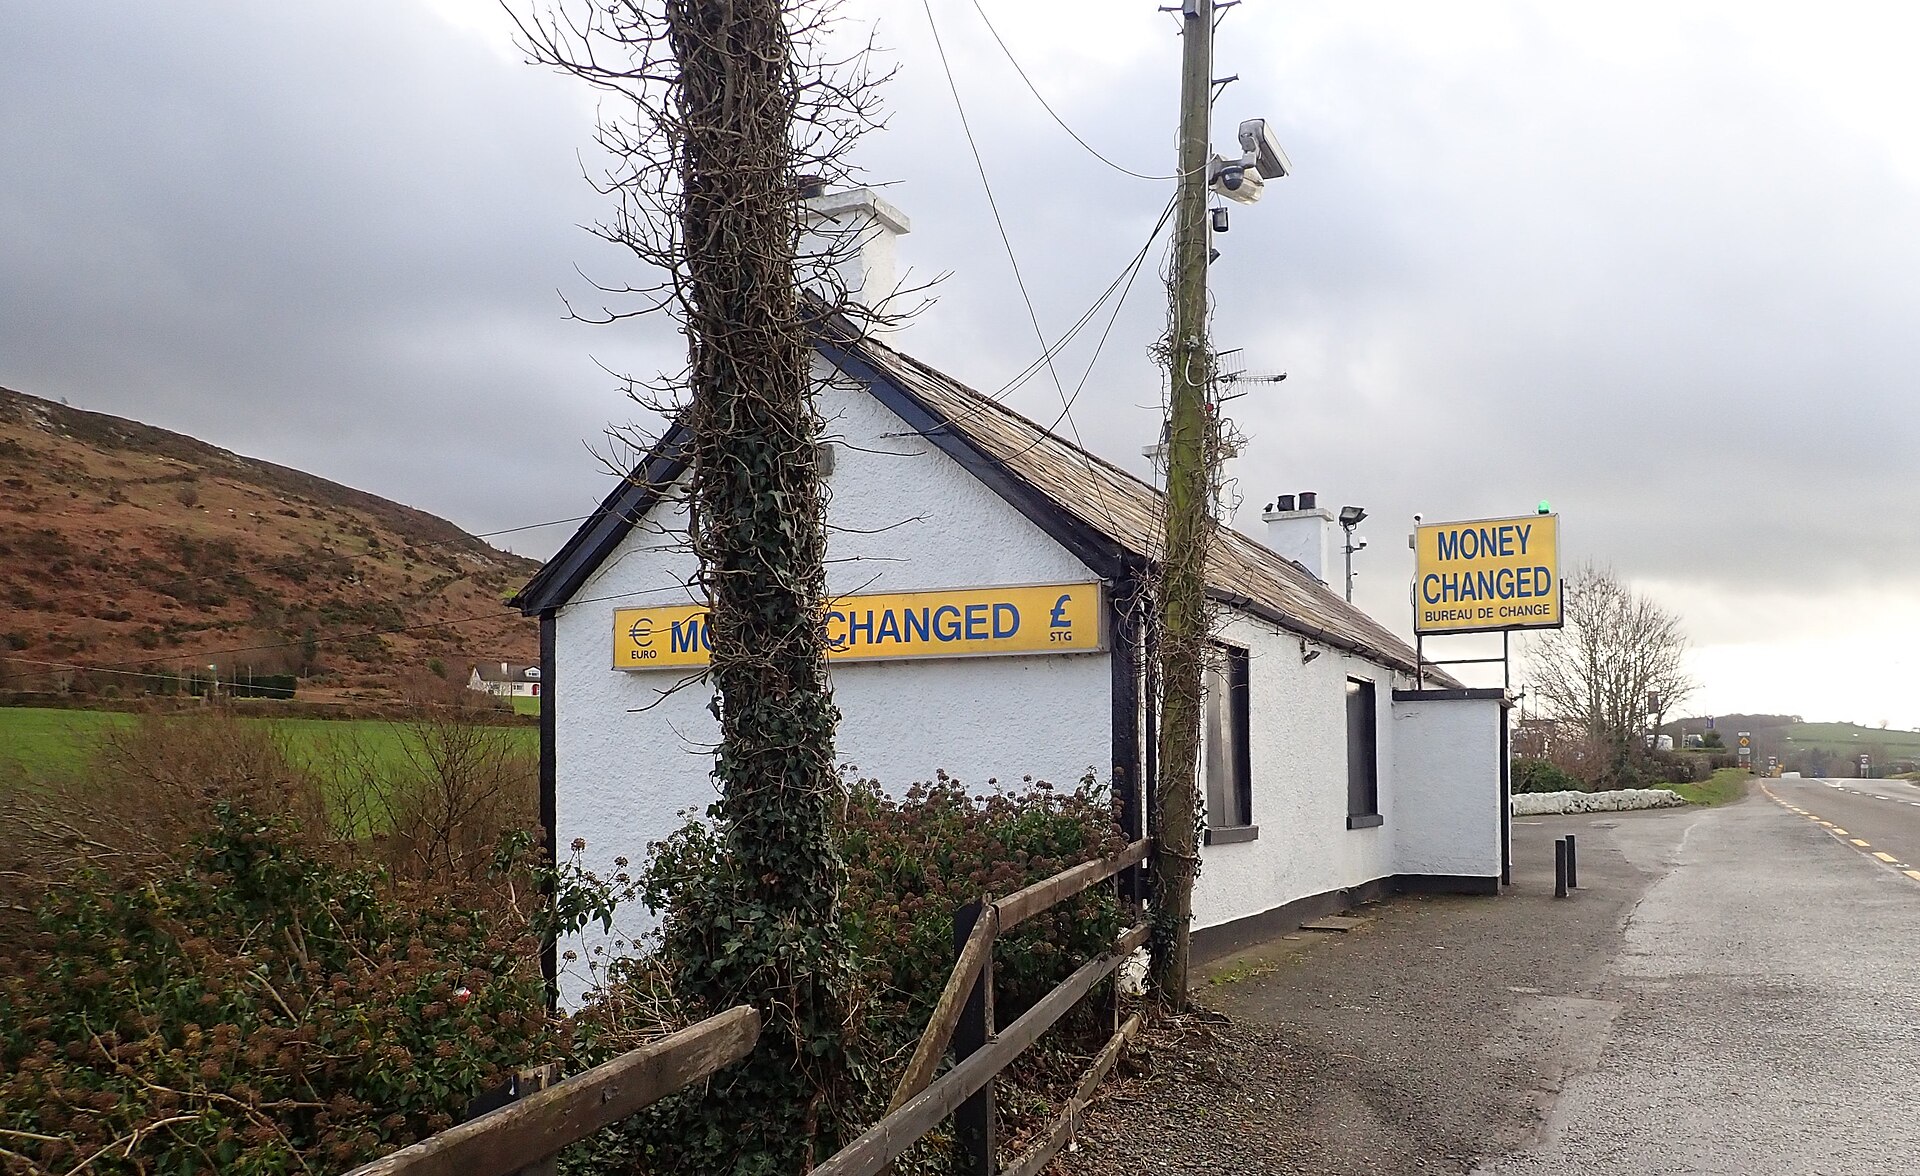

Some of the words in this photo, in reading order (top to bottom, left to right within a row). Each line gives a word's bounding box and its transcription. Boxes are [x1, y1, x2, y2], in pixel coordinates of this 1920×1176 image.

[1437, 524, 1532, 561] MONEY
[1422, 566, 1551, 605] CHANGED
[628, 617, 654, 647] €
[821, 602, 1021, 646] CHANGED
[1050, 594, 1072, 628] £
[1425, 608, 1473, 622] BUREAU
[1477, 607, 1494, 619] DE
[1499, 603, 1550, 617] CHANGE
[1050, 631, 1072, 641] STG
[631, 649, 657, 659] EURO
